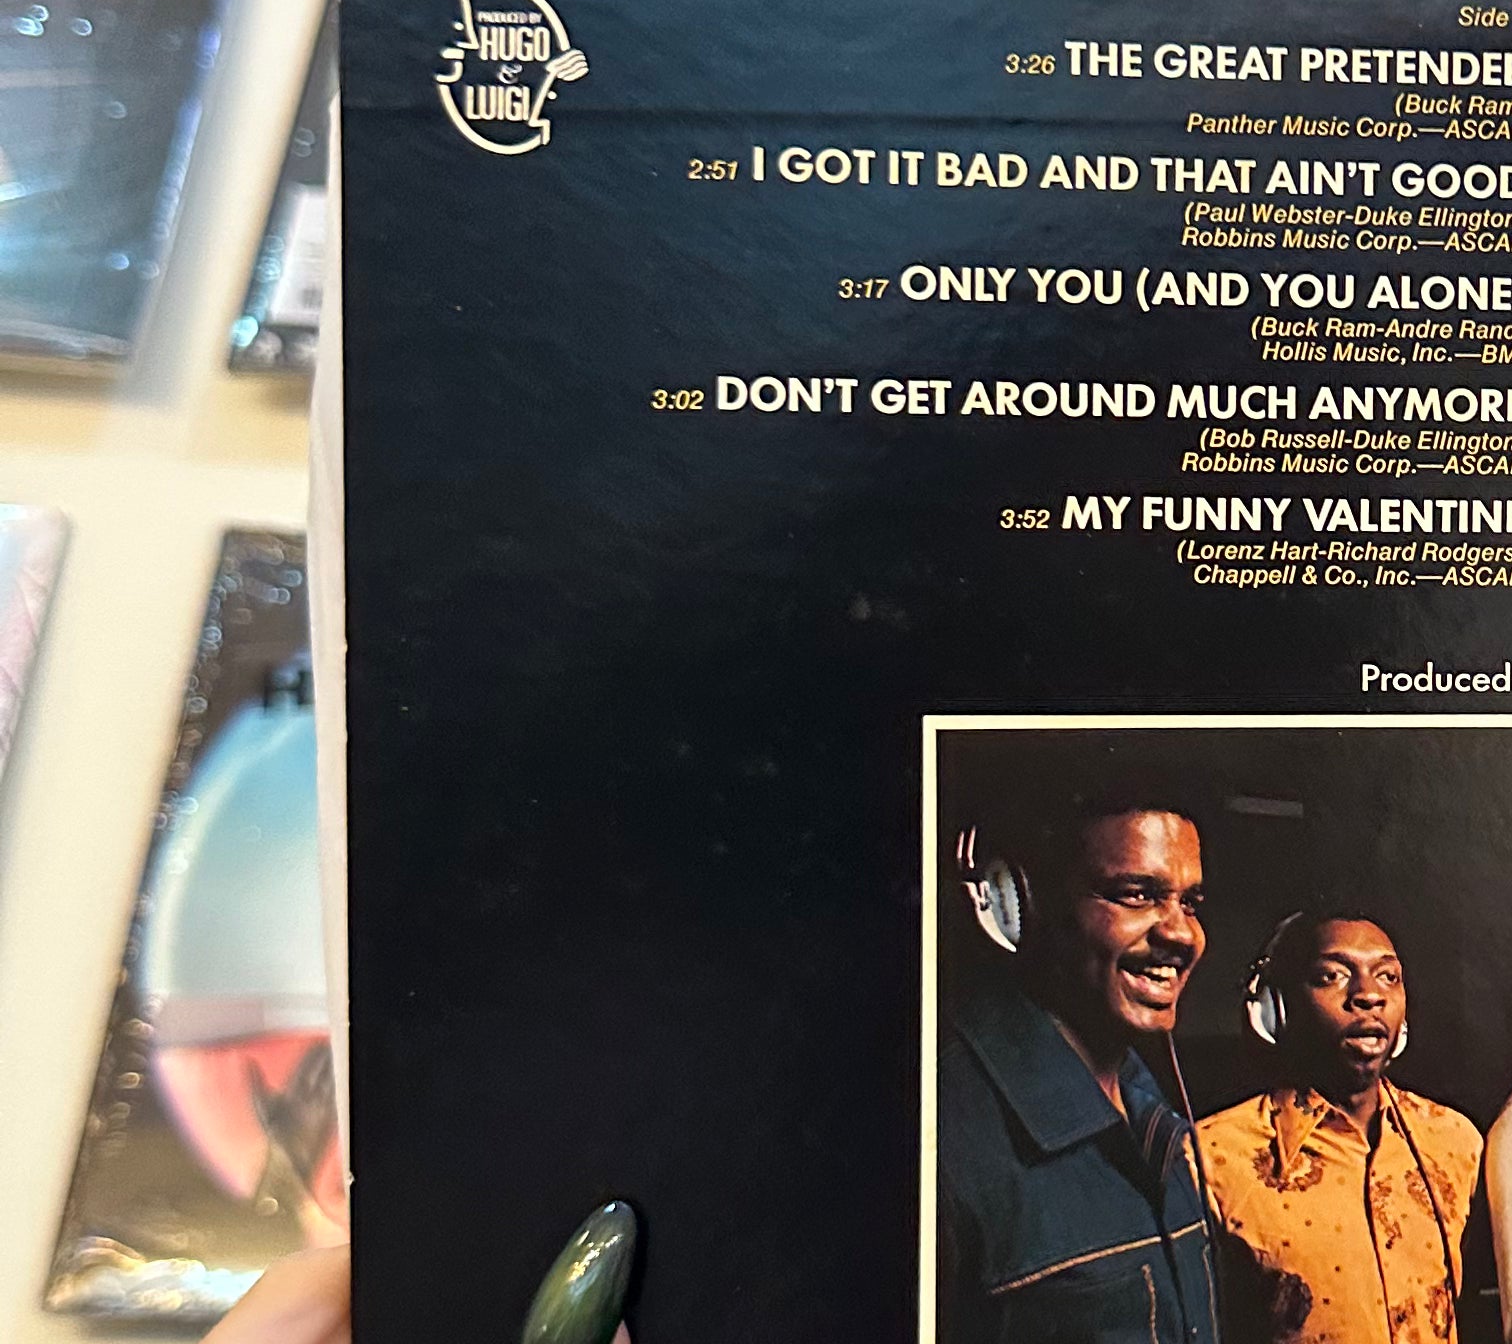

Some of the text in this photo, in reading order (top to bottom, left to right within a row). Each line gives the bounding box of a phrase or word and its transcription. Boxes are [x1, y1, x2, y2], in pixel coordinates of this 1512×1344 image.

[1458, 5, 1510, 28] Side
[479, 26, 551, 62] HUGO
[1004, 53, 1056, 75] 3:26
[1064, 40, 1143, 78] THE
[1153, 43, 1289, 81] GREAT
[465, 85, 531, 122] LUIGI
[1395, 92, 1463, 118] (Buck
[688, 158, 738, 181] 2:51
[752, 147, 765, 181] I
[777, 147, 876, 184] GOT
[888, 149, 925, 186] IT
[936, 151, 1028, 188] BAD
[1039, 154, 1139, 191] AND
[1150, 157, 1257, 194] THAT
[1264, 160, 1381, 197] AIN'T
[1184, 201, 1246, 226] (Paul
[1252, 203, 1413, 227] Webster-Duke
[1181, 226, 1276, 249] Robbins
[1281, 228, 1351, 250] Music
[838, 278, 890, 299] 3:17
[900, 265, 1017, 302] ONLY
[1027, 267, 1123, 305] YOU
[1136, 267, 1250, 313] (AND
[1260, 272, 1355, 309] YOU
[651, 388, 705, 410] 3:02
[716, 375, 859, 413] DON'T
[870, 378, 952, 415] GET
[960, 380, 1156, 418] AROUND
[1166, 384, 1297, 420] MUCH
[1000, 508, 1051, 529] 3:52
[1061, 495, 1132, 530] MY
[1142, 496, 1292, 532] FUNNY
[1361, 661, 1511, 693] Produced
